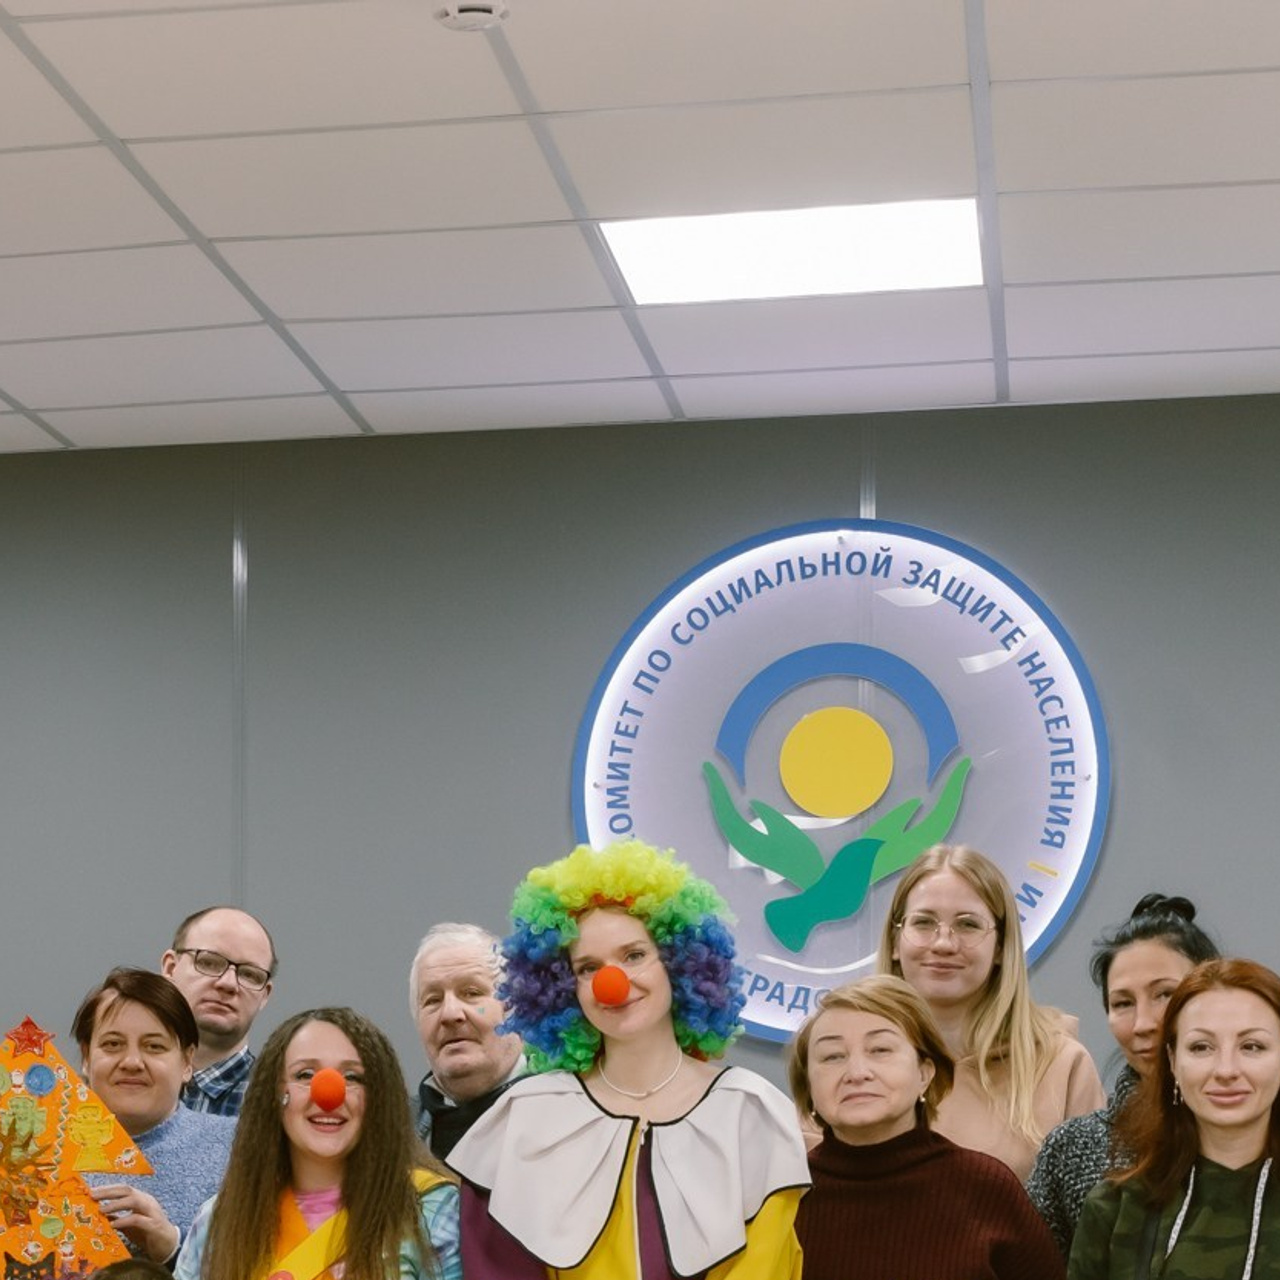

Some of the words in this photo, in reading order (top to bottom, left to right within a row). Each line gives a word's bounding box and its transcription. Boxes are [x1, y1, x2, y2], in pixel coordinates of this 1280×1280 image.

[606, 700, 644, 838] ОМИТЕТ
[632, 649, 672, 695] ПО
[671, 547, 893, 645] СОЦИАЛЬНОЙ
[902, 560, 1028, 652] ЗАЩИТЕ
[1017, 651, 1076, 850] НАСЕЛЕНИЯ
